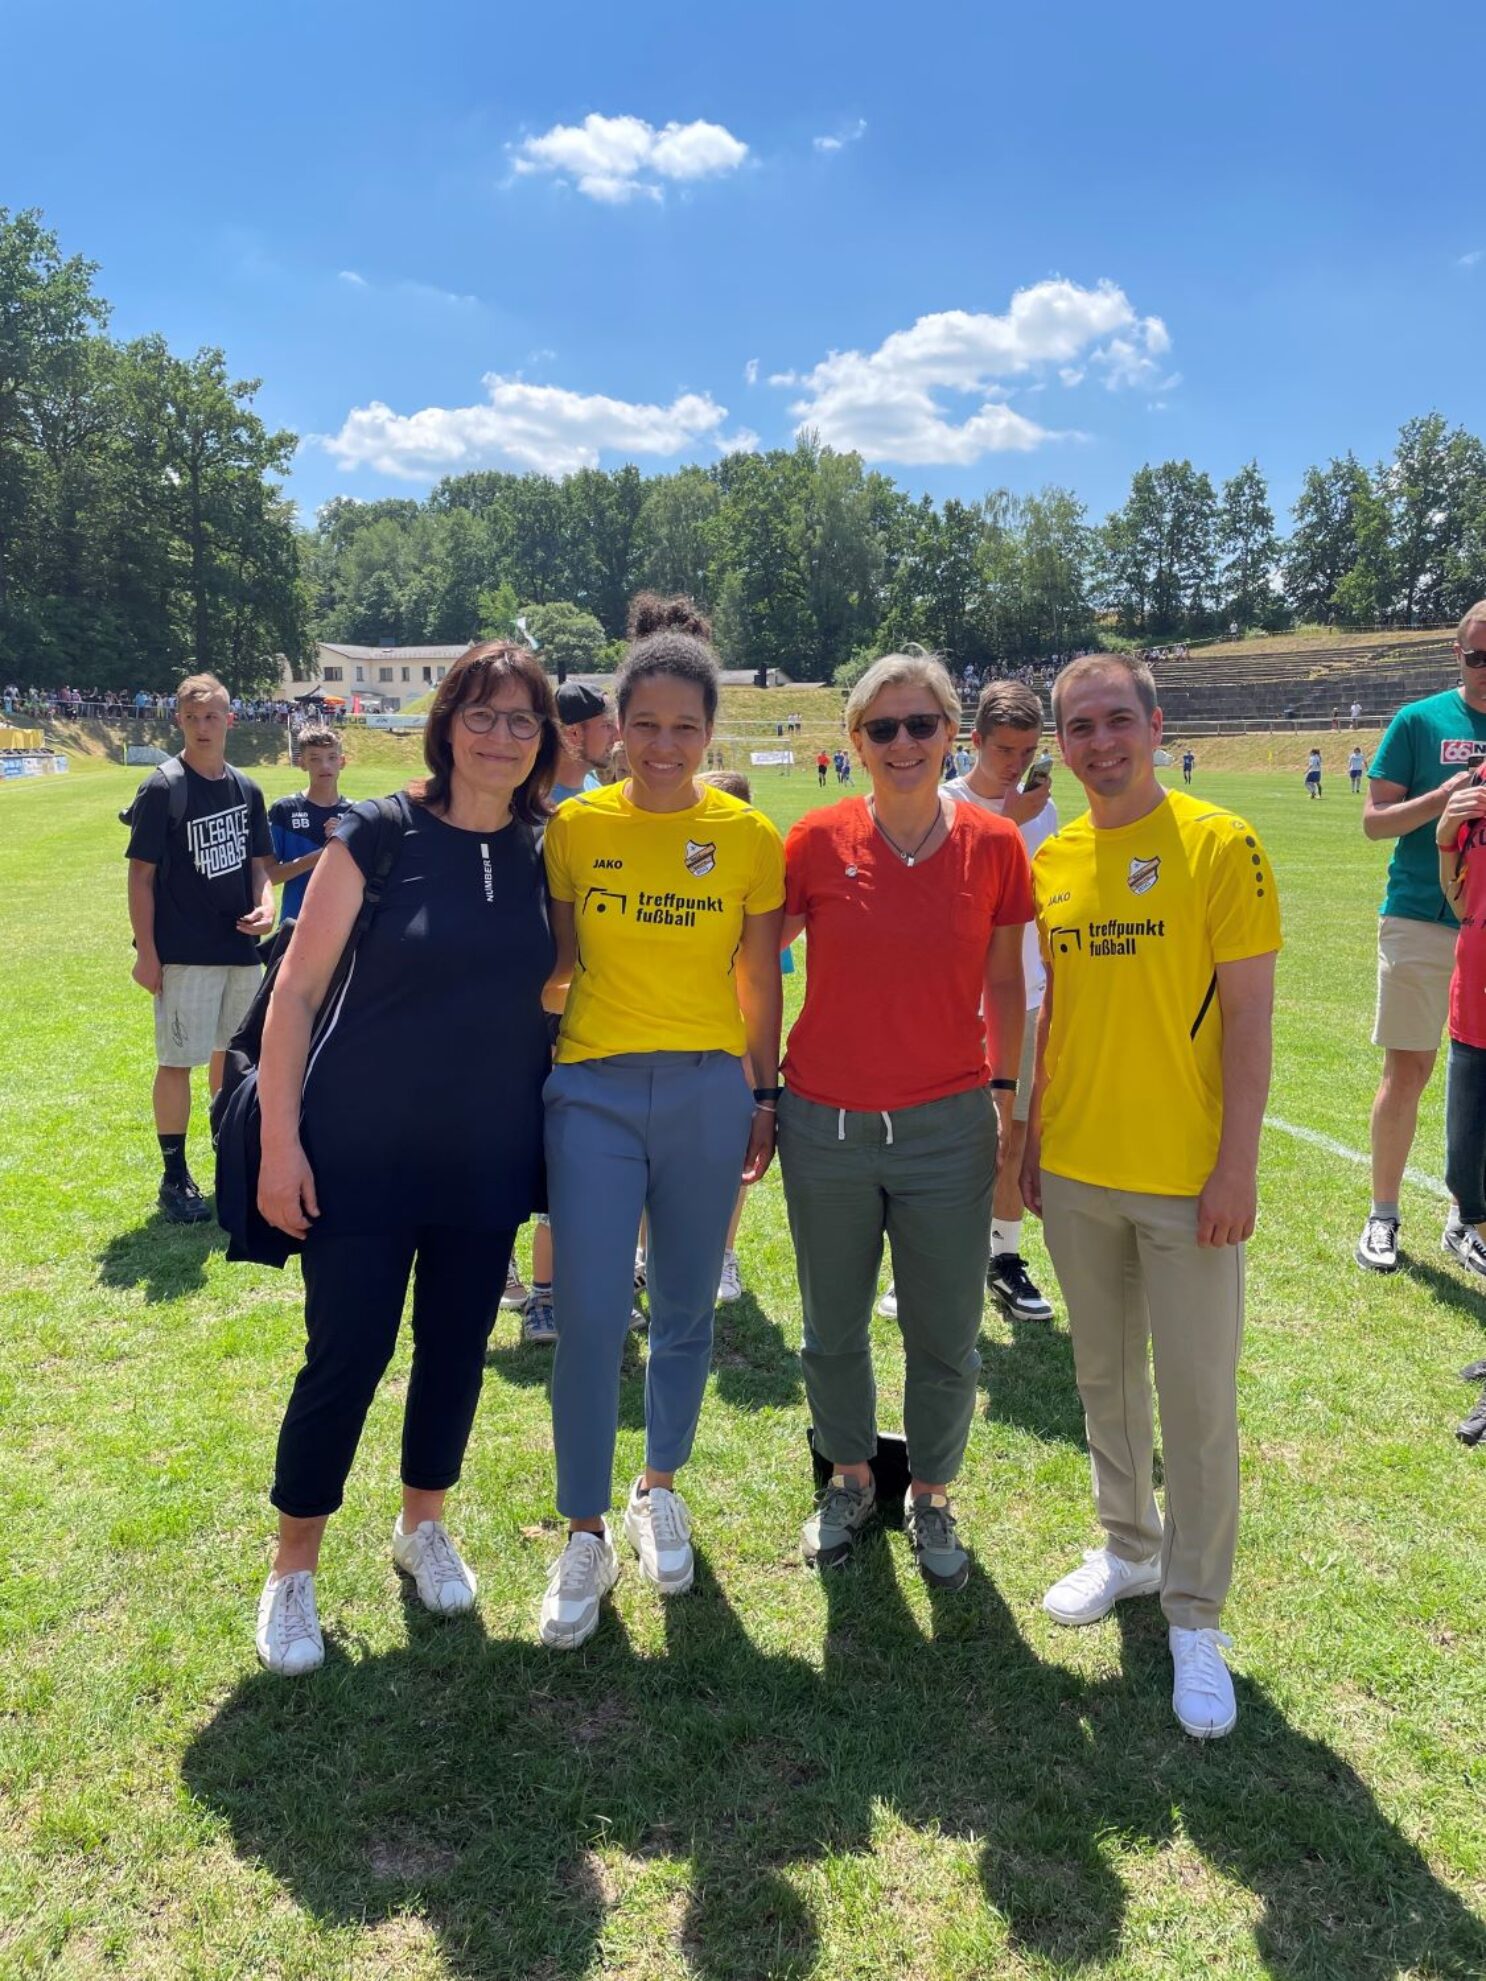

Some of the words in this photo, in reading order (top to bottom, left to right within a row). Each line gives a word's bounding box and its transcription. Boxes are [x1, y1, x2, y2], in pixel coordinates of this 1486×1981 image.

[1444, 742, 1472, 761] 66
[592, 858, 623, 870] JAKO
[483, 859, 494, 902] NUMBER
[638, 891, 724, 913] treffpunkt
[636, 908, 696, 927] fußball
[1089, 918, 1165, 939] treffpunkt
[1089, 938, 1137, 957] fußball
